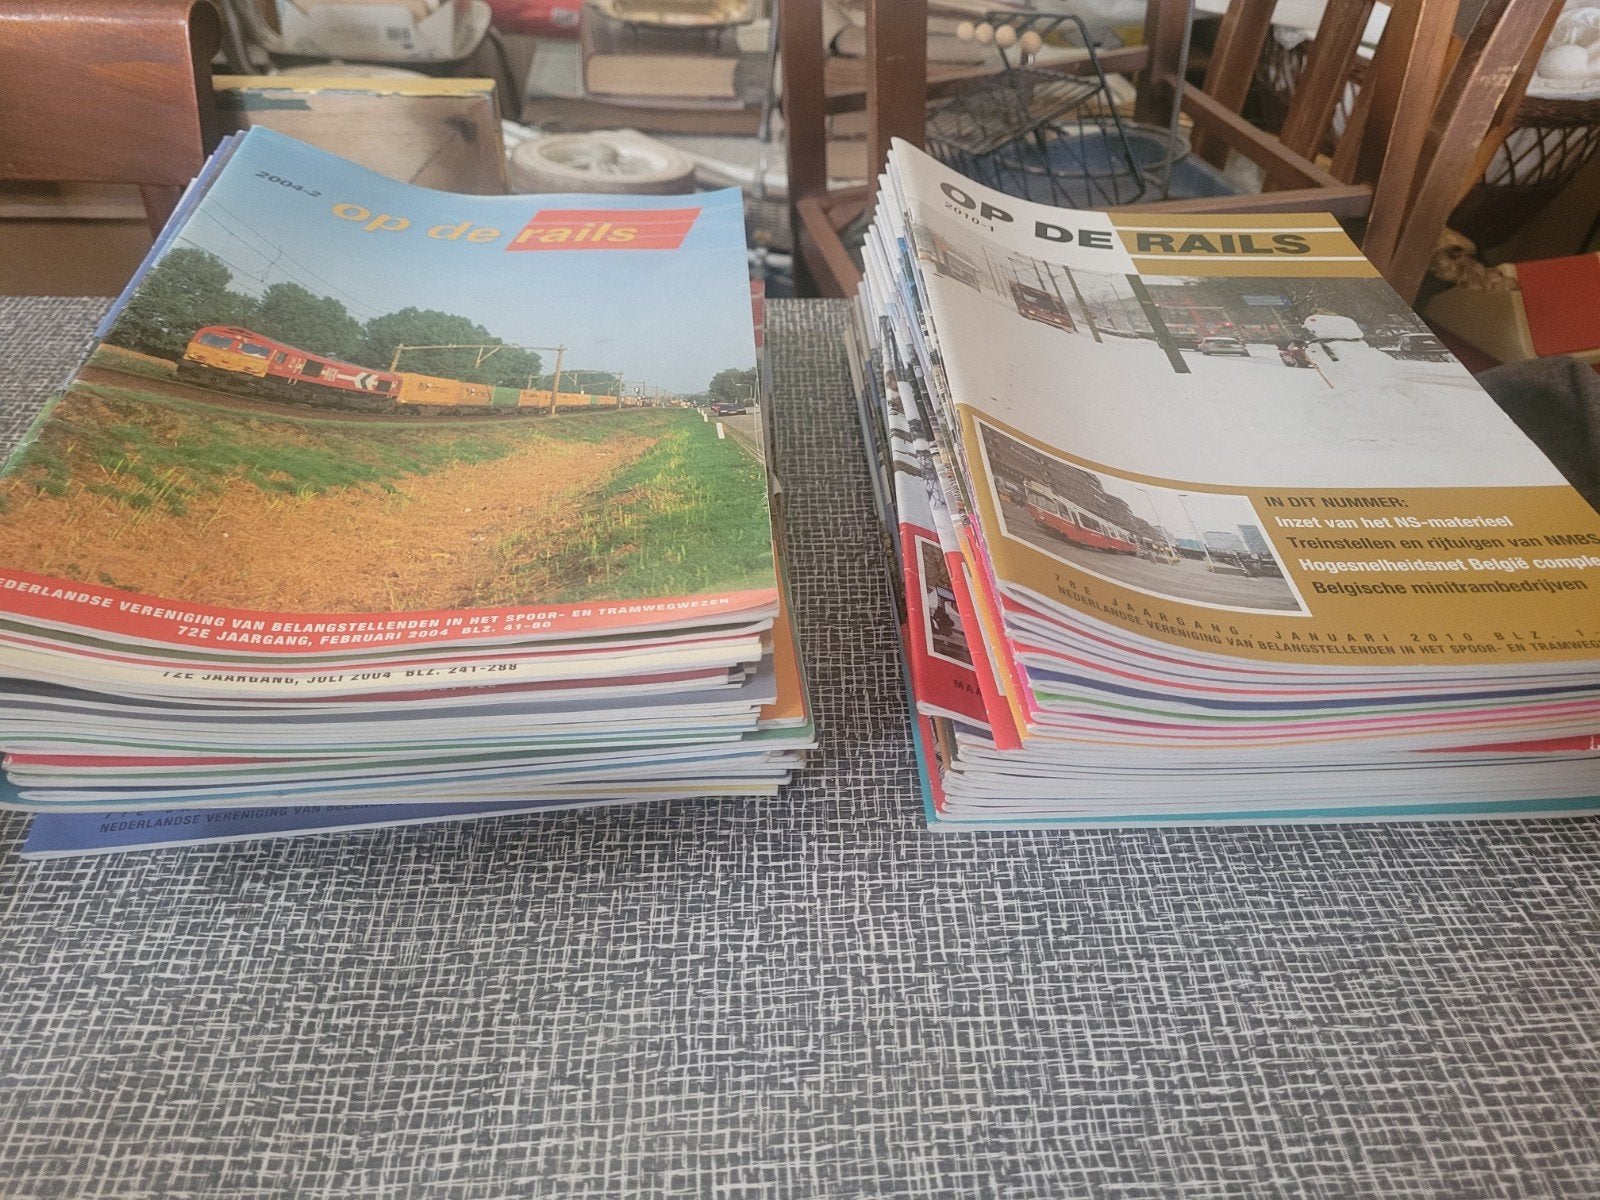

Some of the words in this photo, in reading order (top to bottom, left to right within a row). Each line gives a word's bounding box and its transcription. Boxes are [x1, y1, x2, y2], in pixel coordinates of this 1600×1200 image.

[255, 171, 322, 197] 2004-2
[332, 203, 411, 232] op
[426, 220, 501, 243] de
[516, 222, 638, 244] rails
[940, 182, 1014, 222] OP
[1035, 221, 1114, 250] DE
[1136, 233, 1311, 254] RAILS
[944, 201, 995, 232] 2010-1
[1264, 496, 1285, 507] IN
[1287, 497, 1317, 508] DIT
[1321, 497, 1409, 508] NUMMER:
[1274, 516, 1323, 528] Inzet
[1325, 517, 1359, 529] van
[1360, 516, 1394, 528] het
[1392, 515, 1514, 528] NS-materieel
[1286, 536, 1397, 549] Treinstellen
[1399, 539, 1424, 549] en
[1427, 537, 1506, 550] rijtuigen
[1506, 536, 1544, 548] van
[1298, 558, 1468, 574] Hogesnelheidsnet
[1467, 556, 1530, 572] België
[1312, 581, 1407, 596] Belgische
[1410, 579, 1588, 594] minitrambedrijven
[119, 601, 226, 627] VERENIGING
[231, 618, 266, 631] VAN
[271, 619, 439, 633] BELANGSTELLENDEN
[445, 617, 464, 627] IN
[469, 615, 500, 625] HET
[505, 612, 566, 622] SPOOR-
[571, 609, 592, 618] EN
[598, 597, 730, 615] TRAMWEGWEZEN
[1057, 584, 1144, 625] NEDERLANDSE
[1147, 619, 1223, 644] VERENIGING
[1226, 636, 1255, 649] VAN
[1257, 640, 1396, 655] BELANGSTELLENDEN
[1399, 645, 1415, 655] IN
[1419, 645, 1446, 654] HET
[1449, 644, 1502, 654] SPOOR-
[1506, 643, 1526, 652] EN
[177, 626, 211, 638] 72E
[216, 631, 313, 647] JAARGANG,
[319, 632, 403, 645] FEBRUARI
[407, 628, 449, 638] 2004
[461, 625, 496, 635] BLZ.
[503, 621, 552, 631] 41-80
[99, 814, 201, 833] NEDERLANDSE
[206, 806, 288, 823] VERENIGING
